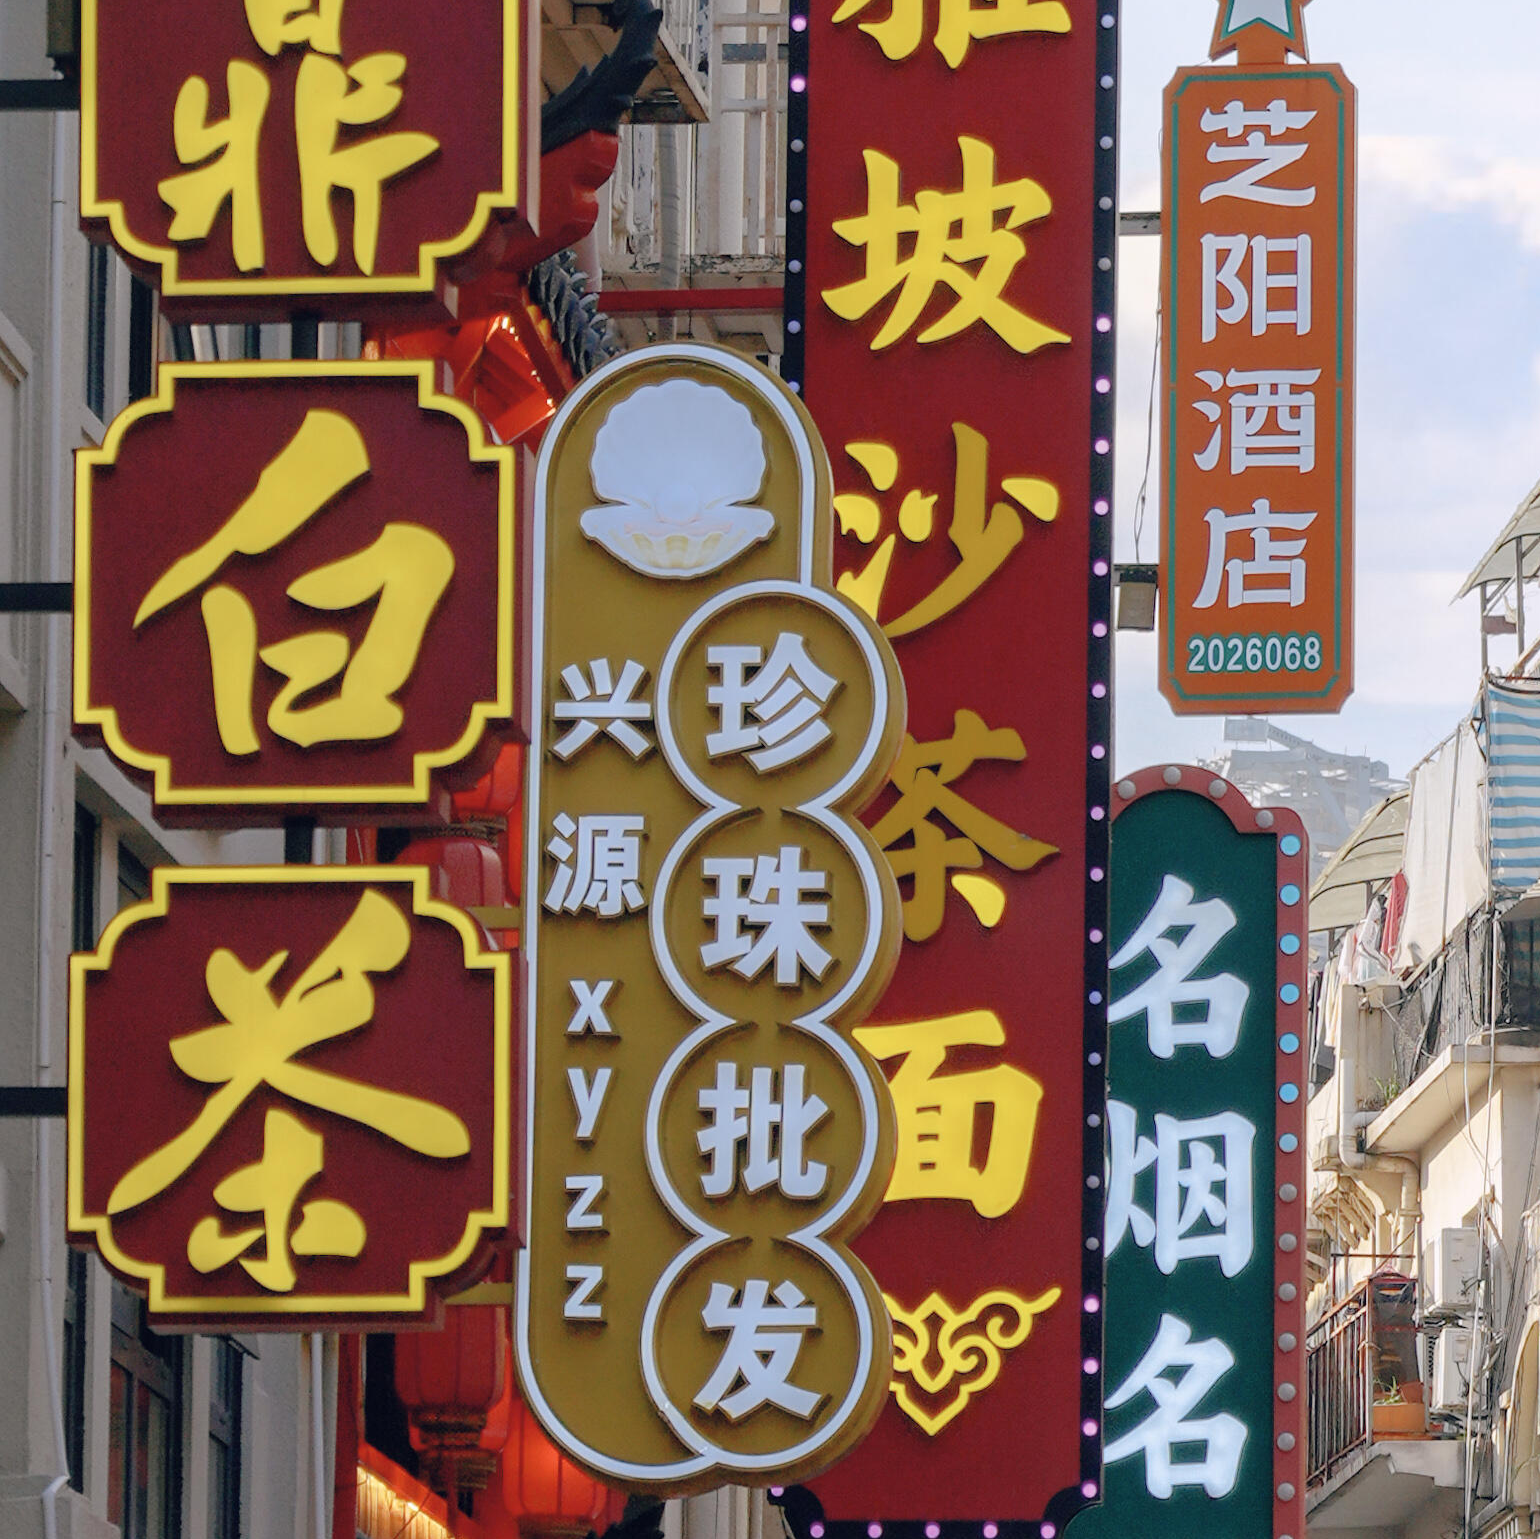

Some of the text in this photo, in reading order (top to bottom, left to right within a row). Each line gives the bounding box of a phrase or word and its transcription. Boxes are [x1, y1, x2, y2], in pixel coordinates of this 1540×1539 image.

[1193, 98, 1318, 612] 芝阳酒店
[543, 658, 653, 918] 兴源
[1186, 635, 1322, 674] 2026068
[692, 631, 838, 1421] 珍珠批发
